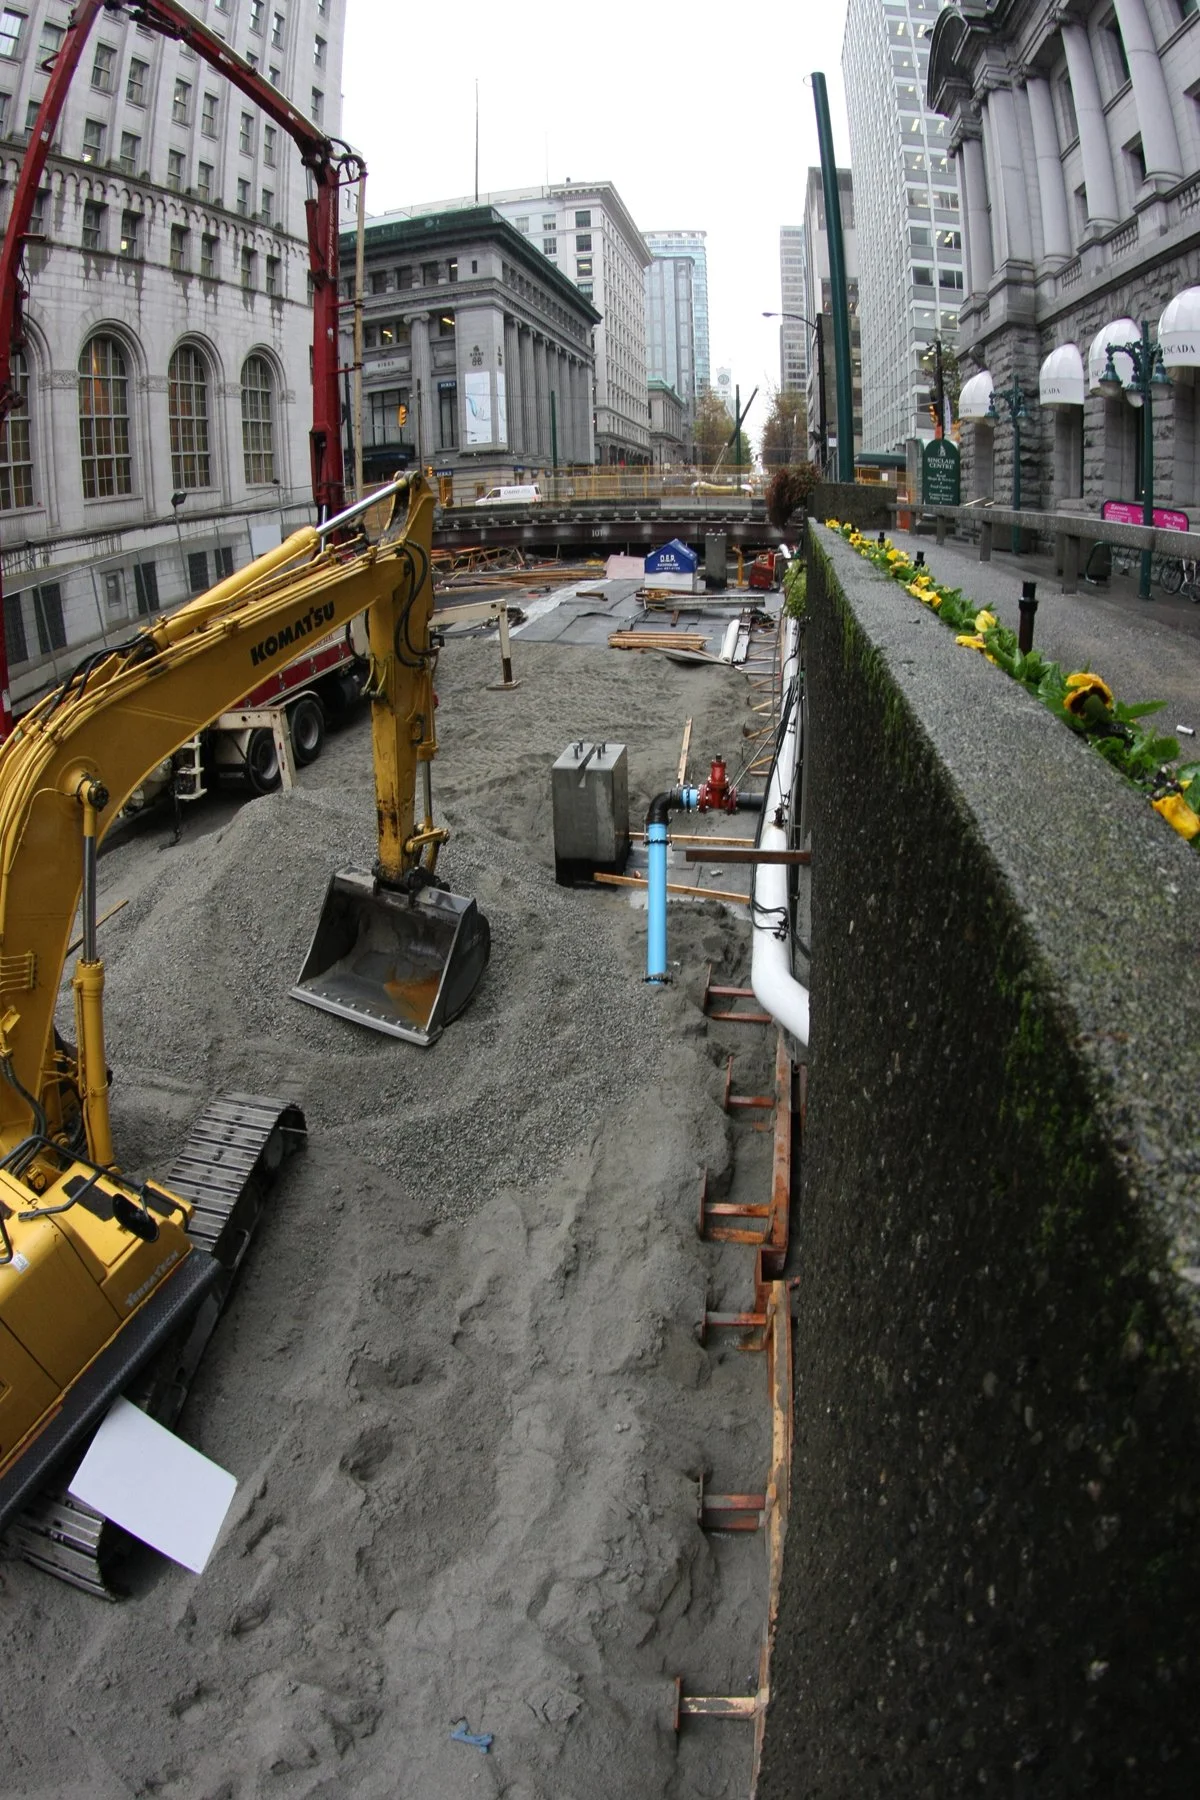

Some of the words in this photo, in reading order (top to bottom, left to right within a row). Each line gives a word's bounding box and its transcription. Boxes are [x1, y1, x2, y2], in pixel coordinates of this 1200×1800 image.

[1163, 344, 1195, 354] ESCADA
[927, 457, 956, 465] SINCLAIR
[929, 462, 954, 470] CENTRE
[250, 601, 335, 667] KOMATSU
